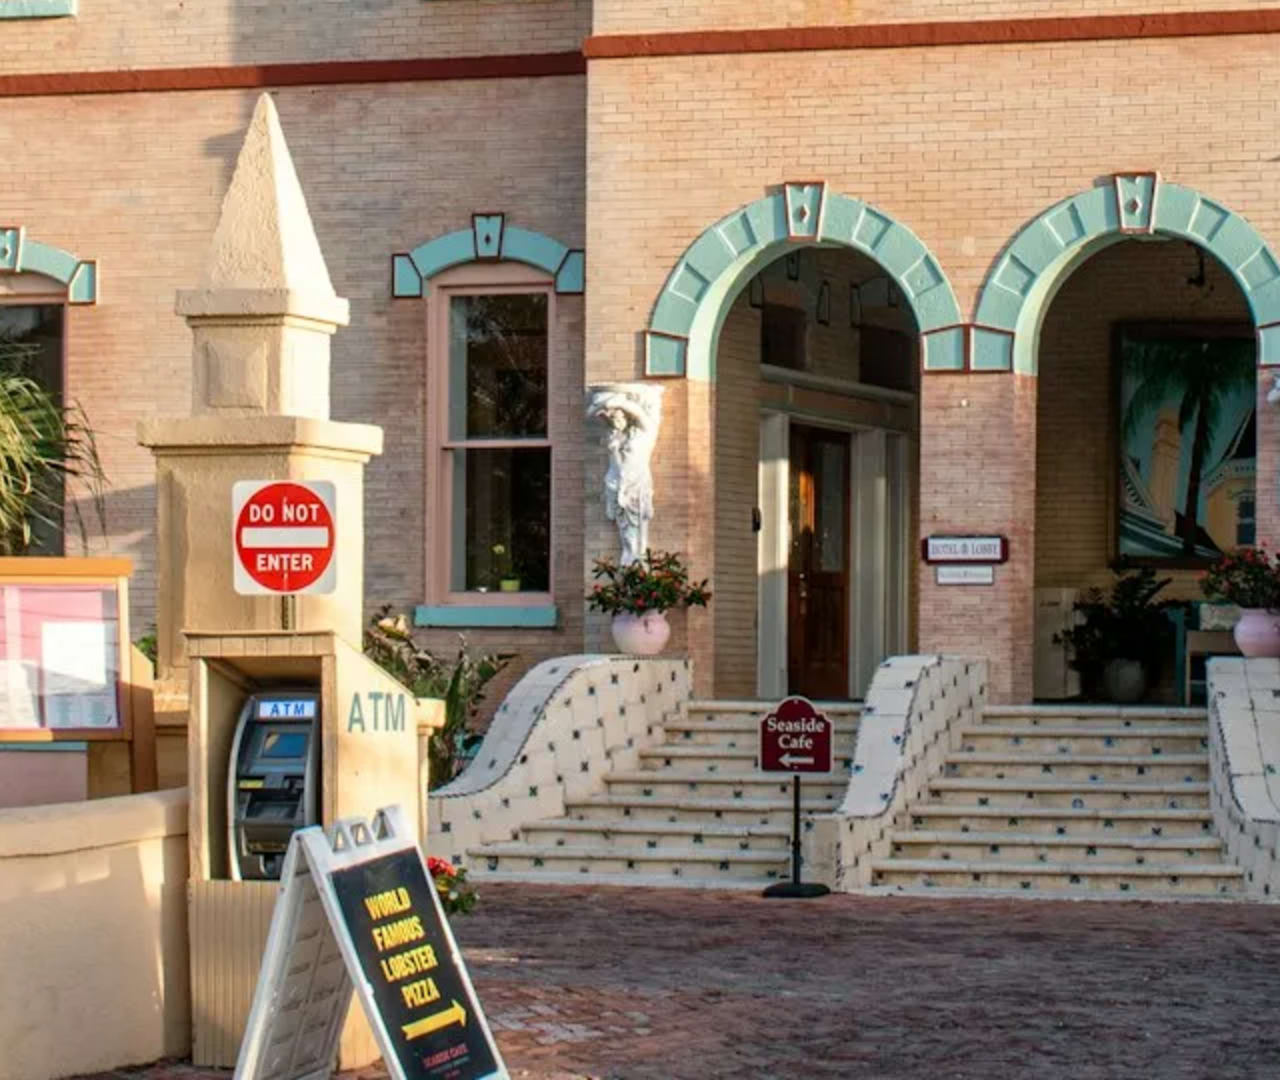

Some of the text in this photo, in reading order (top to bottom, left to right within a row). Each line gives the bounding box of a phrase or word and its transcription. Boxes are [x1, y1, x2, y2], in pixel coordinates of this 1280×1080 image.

[249, 503, 320, 523] DO NOT
[256, 553, 313, 572] ENTER
[270, 703, 305, 716] ATM
[347, 691, 406, 733] ATM
[767, 717, 825, 733] Seaside
[778, 734, 813, 750] Cafe
[364, 887, 412, 920] WORLD
[372, 915, 426, 952] FAMOUS
[381, 944, 439, 983] LOBSTER
[401, 977, 441, 1008] PIZZA
